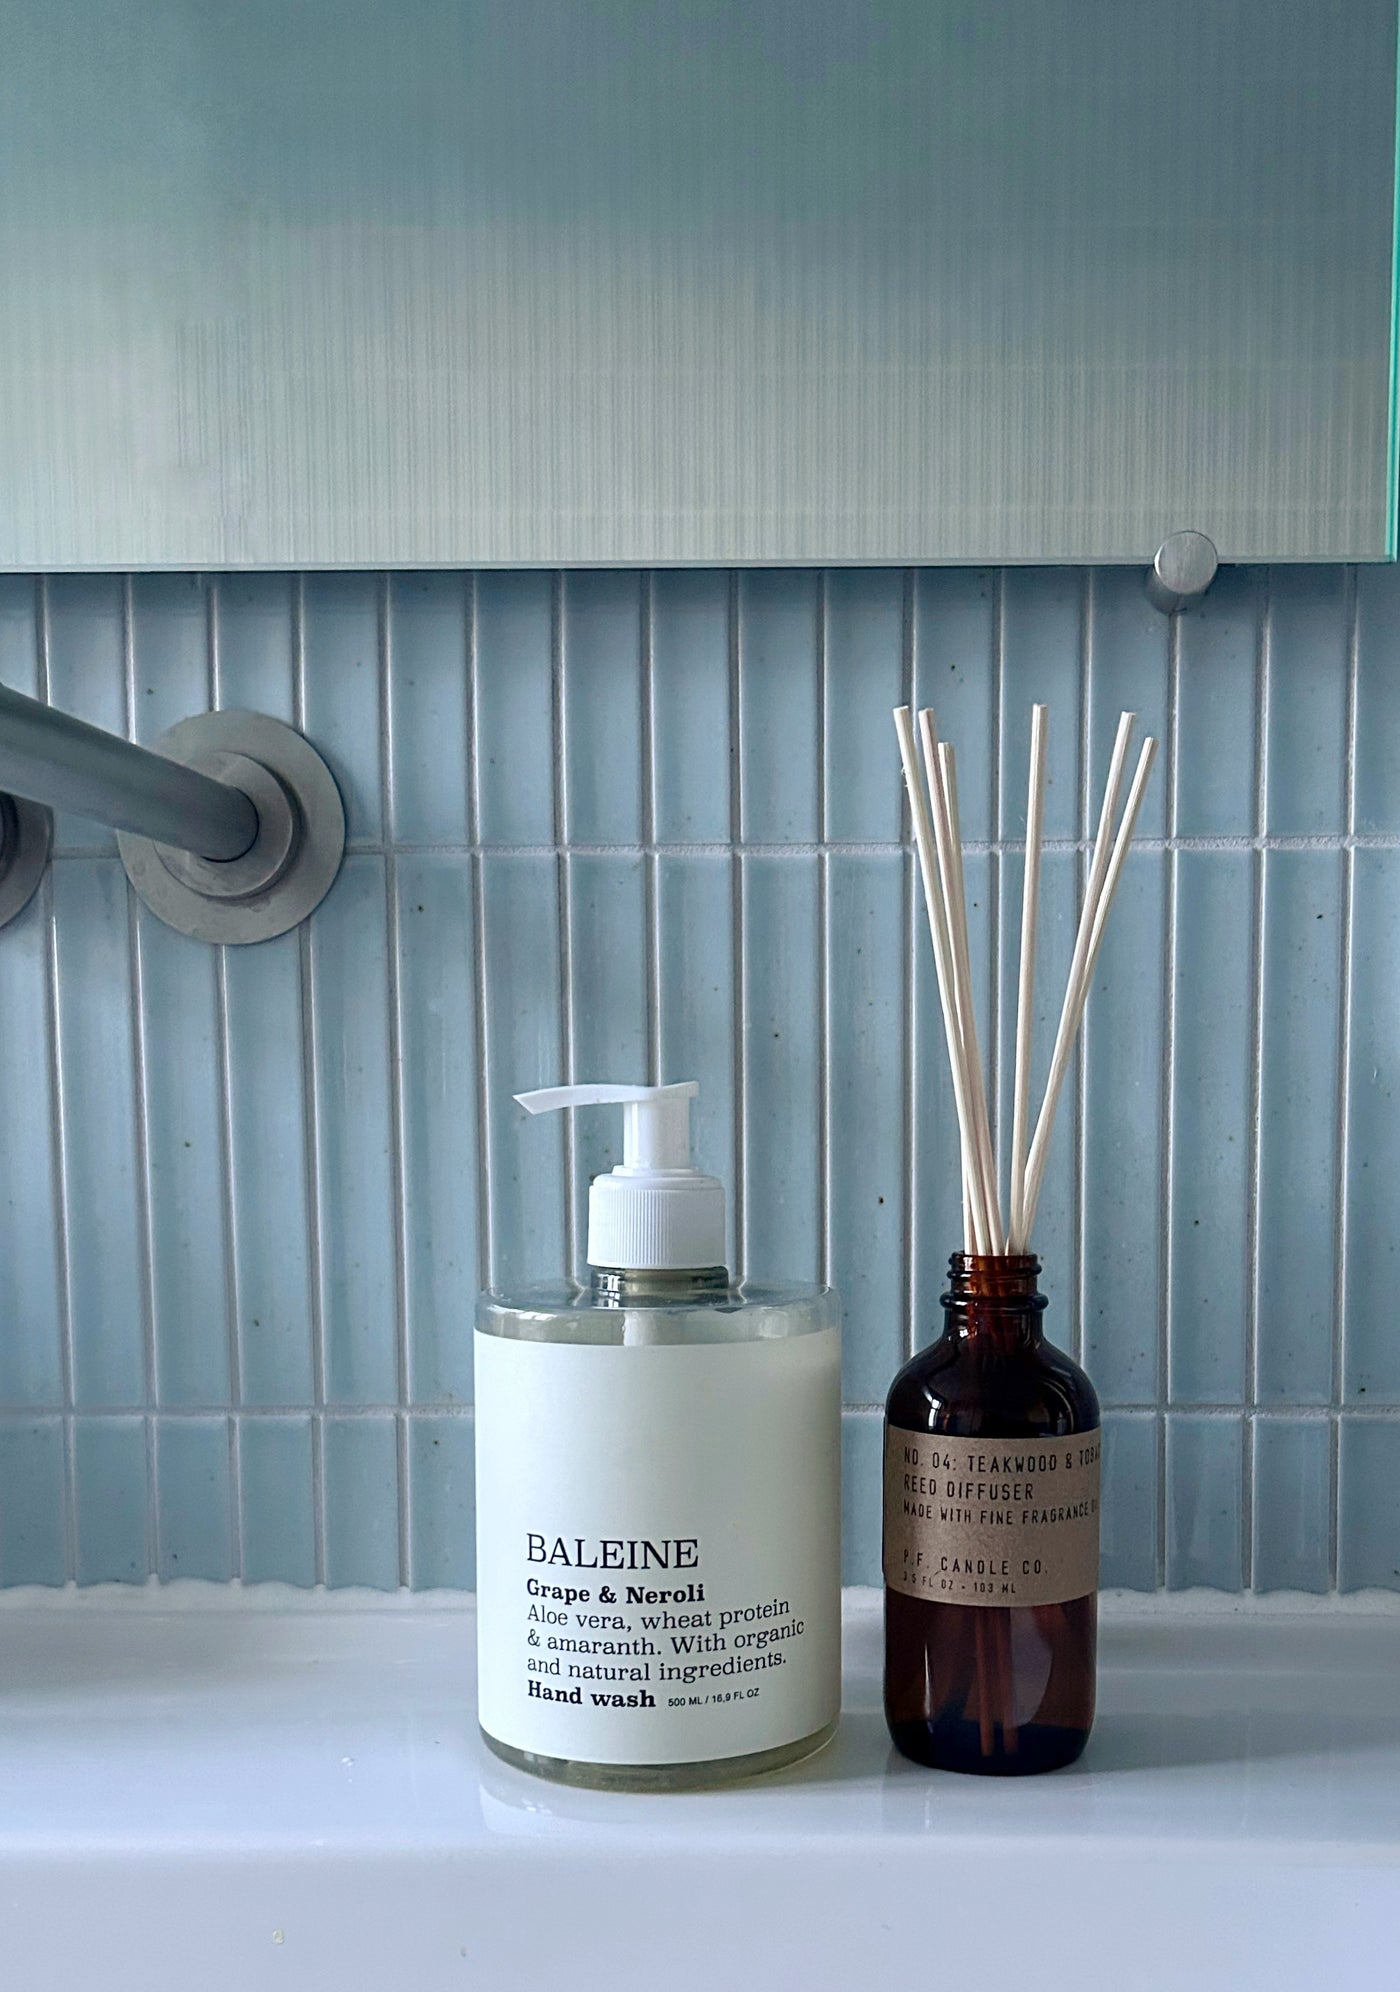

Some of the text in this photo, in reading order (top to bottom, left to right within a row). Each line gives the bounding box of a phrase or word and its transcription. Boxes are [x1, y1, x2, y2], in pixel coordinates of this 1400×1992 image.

[932, 1451, 957, 1471] 04:
[967, 1453, 1057, 1473] TEAKWOOD
[1065, 1452, 1072, 1469] &
[904, 1473, 1034, 1501] REED DIFFUSER
[903, 1498, 932, 1519] MADE
[940, 1506, 971, 1523] WITH
[980, 1510, 1014, 1525] FINE
[1022, 1500, 1089, 1525] FRAGRANCE
[526, 1532, 699, 1570] BALEINE
[903, 1548, 1048, 1575] P.F. CANDLE CO.
[527, 1578, 705, 1606] Grape & Neroli
[922, 1575, 934, 1588] FL
[941, 1578, 954, 1591] OZ
[973, 1582, 994, 1593] 103
[1001, 1583, 1017, 1594] ML
[527, 1598, 790, 1632] Aloe vera, wheat protein
[527, 1618, 805, 1656] & amaranth. With organic
[527, 1652, 787, 1684] and natural ingredients.
[527, 1679, 583, 1705] Hand
[590, 1689, 656, 1708] wash
[668, 1697, 686, 1707] 500
[688, 1696, 703, 1706] ML
[733, 1691, 745, 1701] FL
[746, 1687, 760, 1699] OZ
